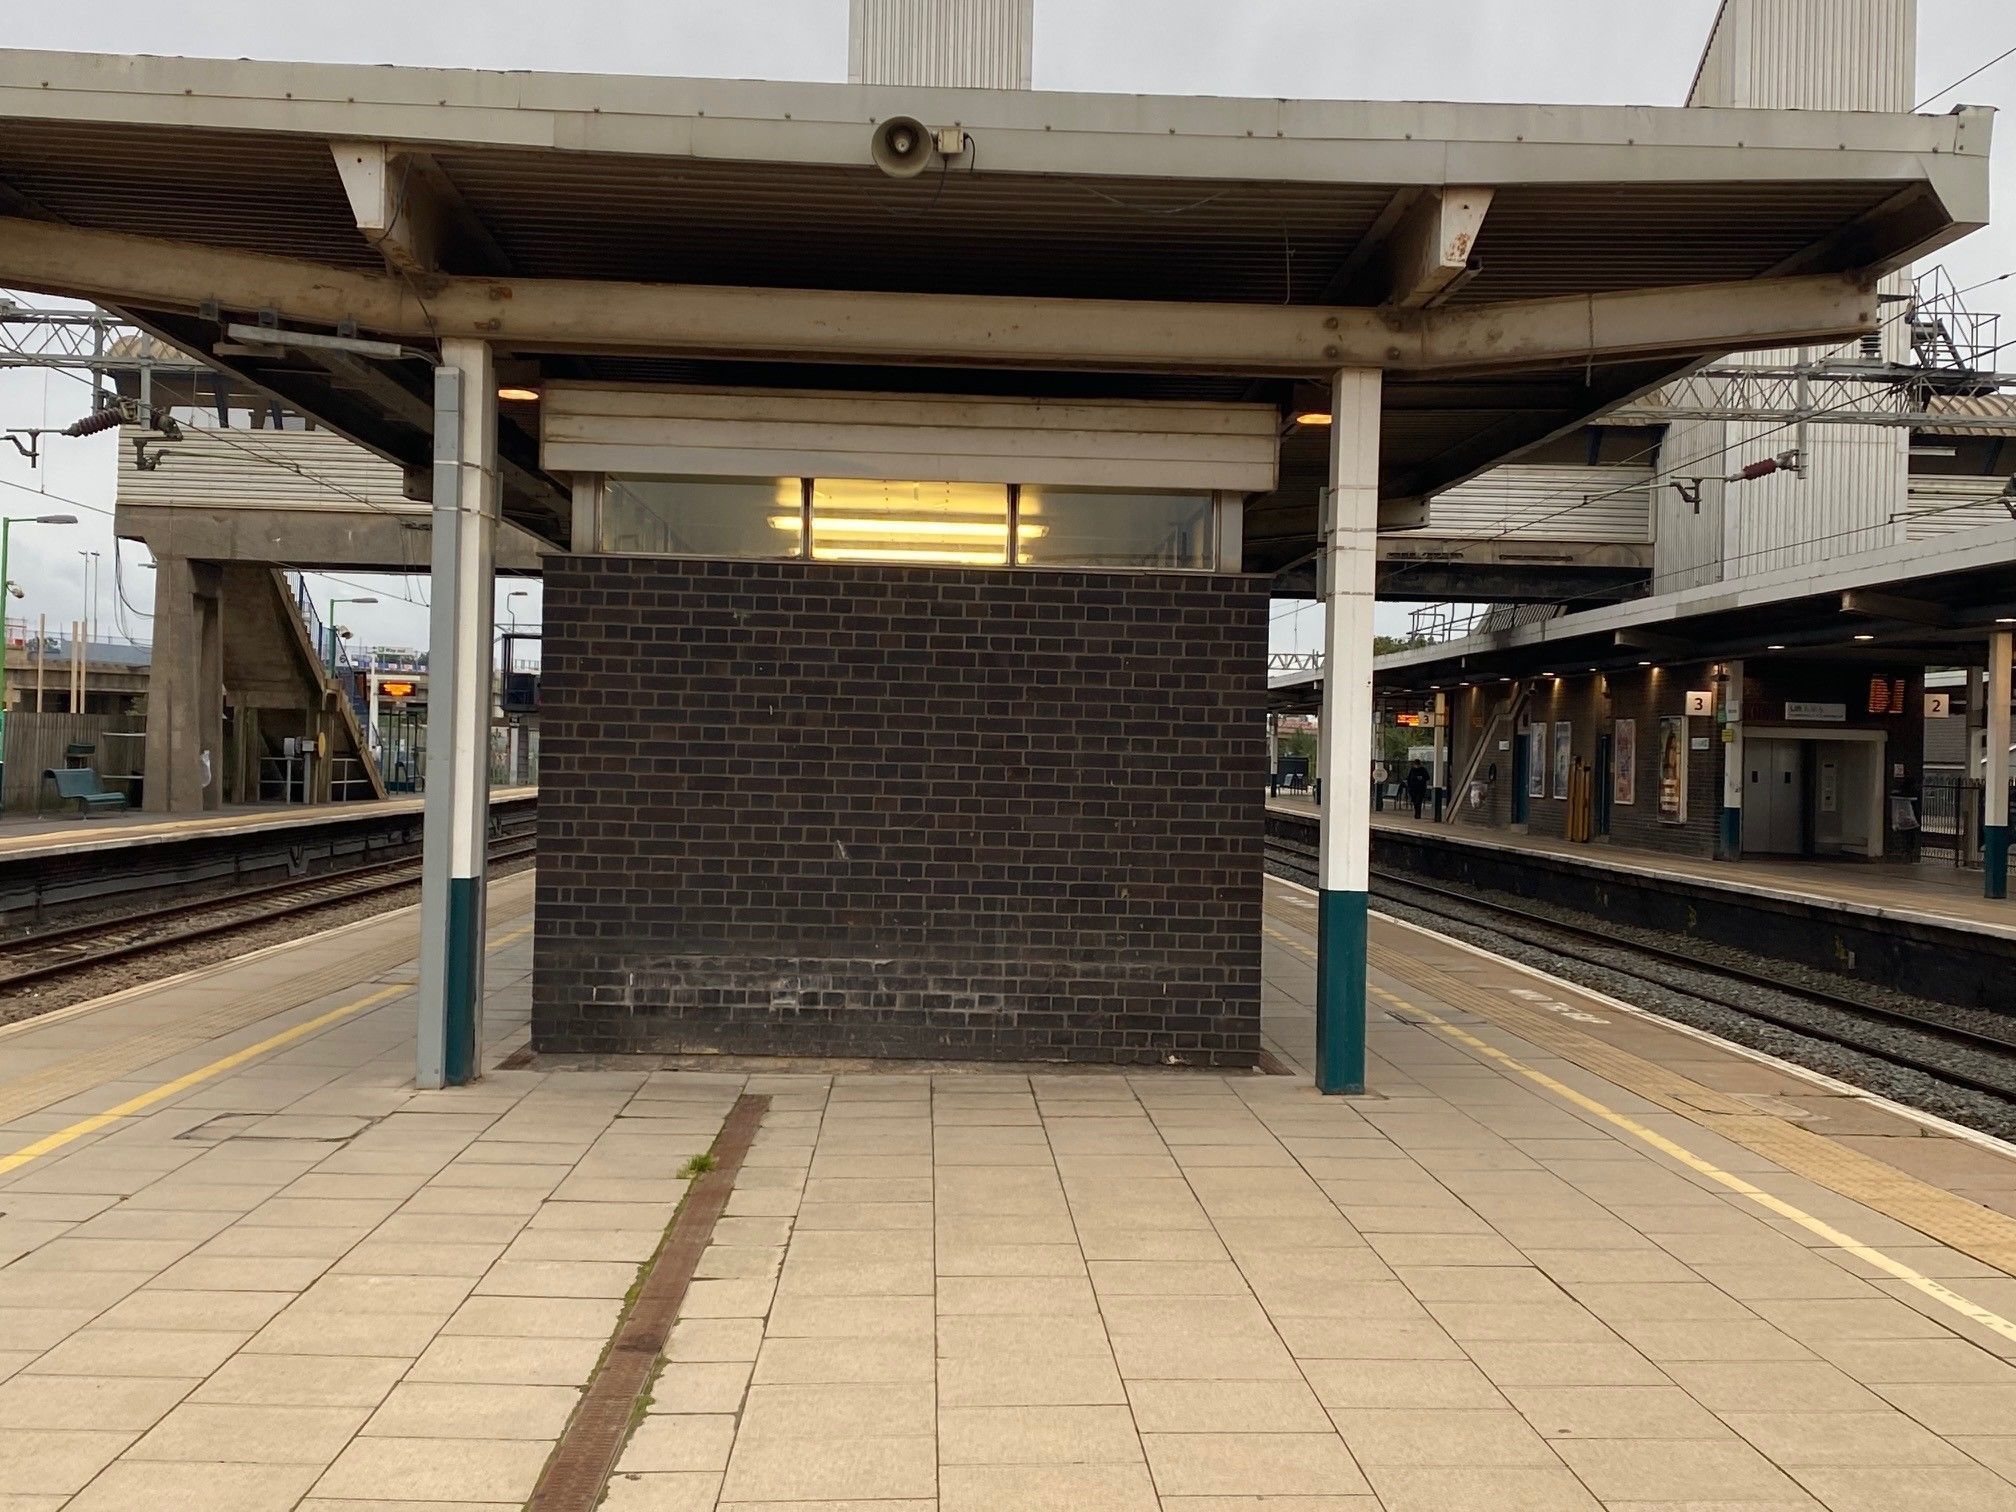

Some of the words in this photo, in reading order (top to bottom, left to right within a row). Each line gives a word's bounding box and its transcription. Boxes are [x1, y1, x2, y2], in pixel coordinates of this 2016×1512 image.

[1694, 697, 1703, 710] 3
[1932, 699, 1941, 712] 2
[1423, 715, 1429, 724] 3
